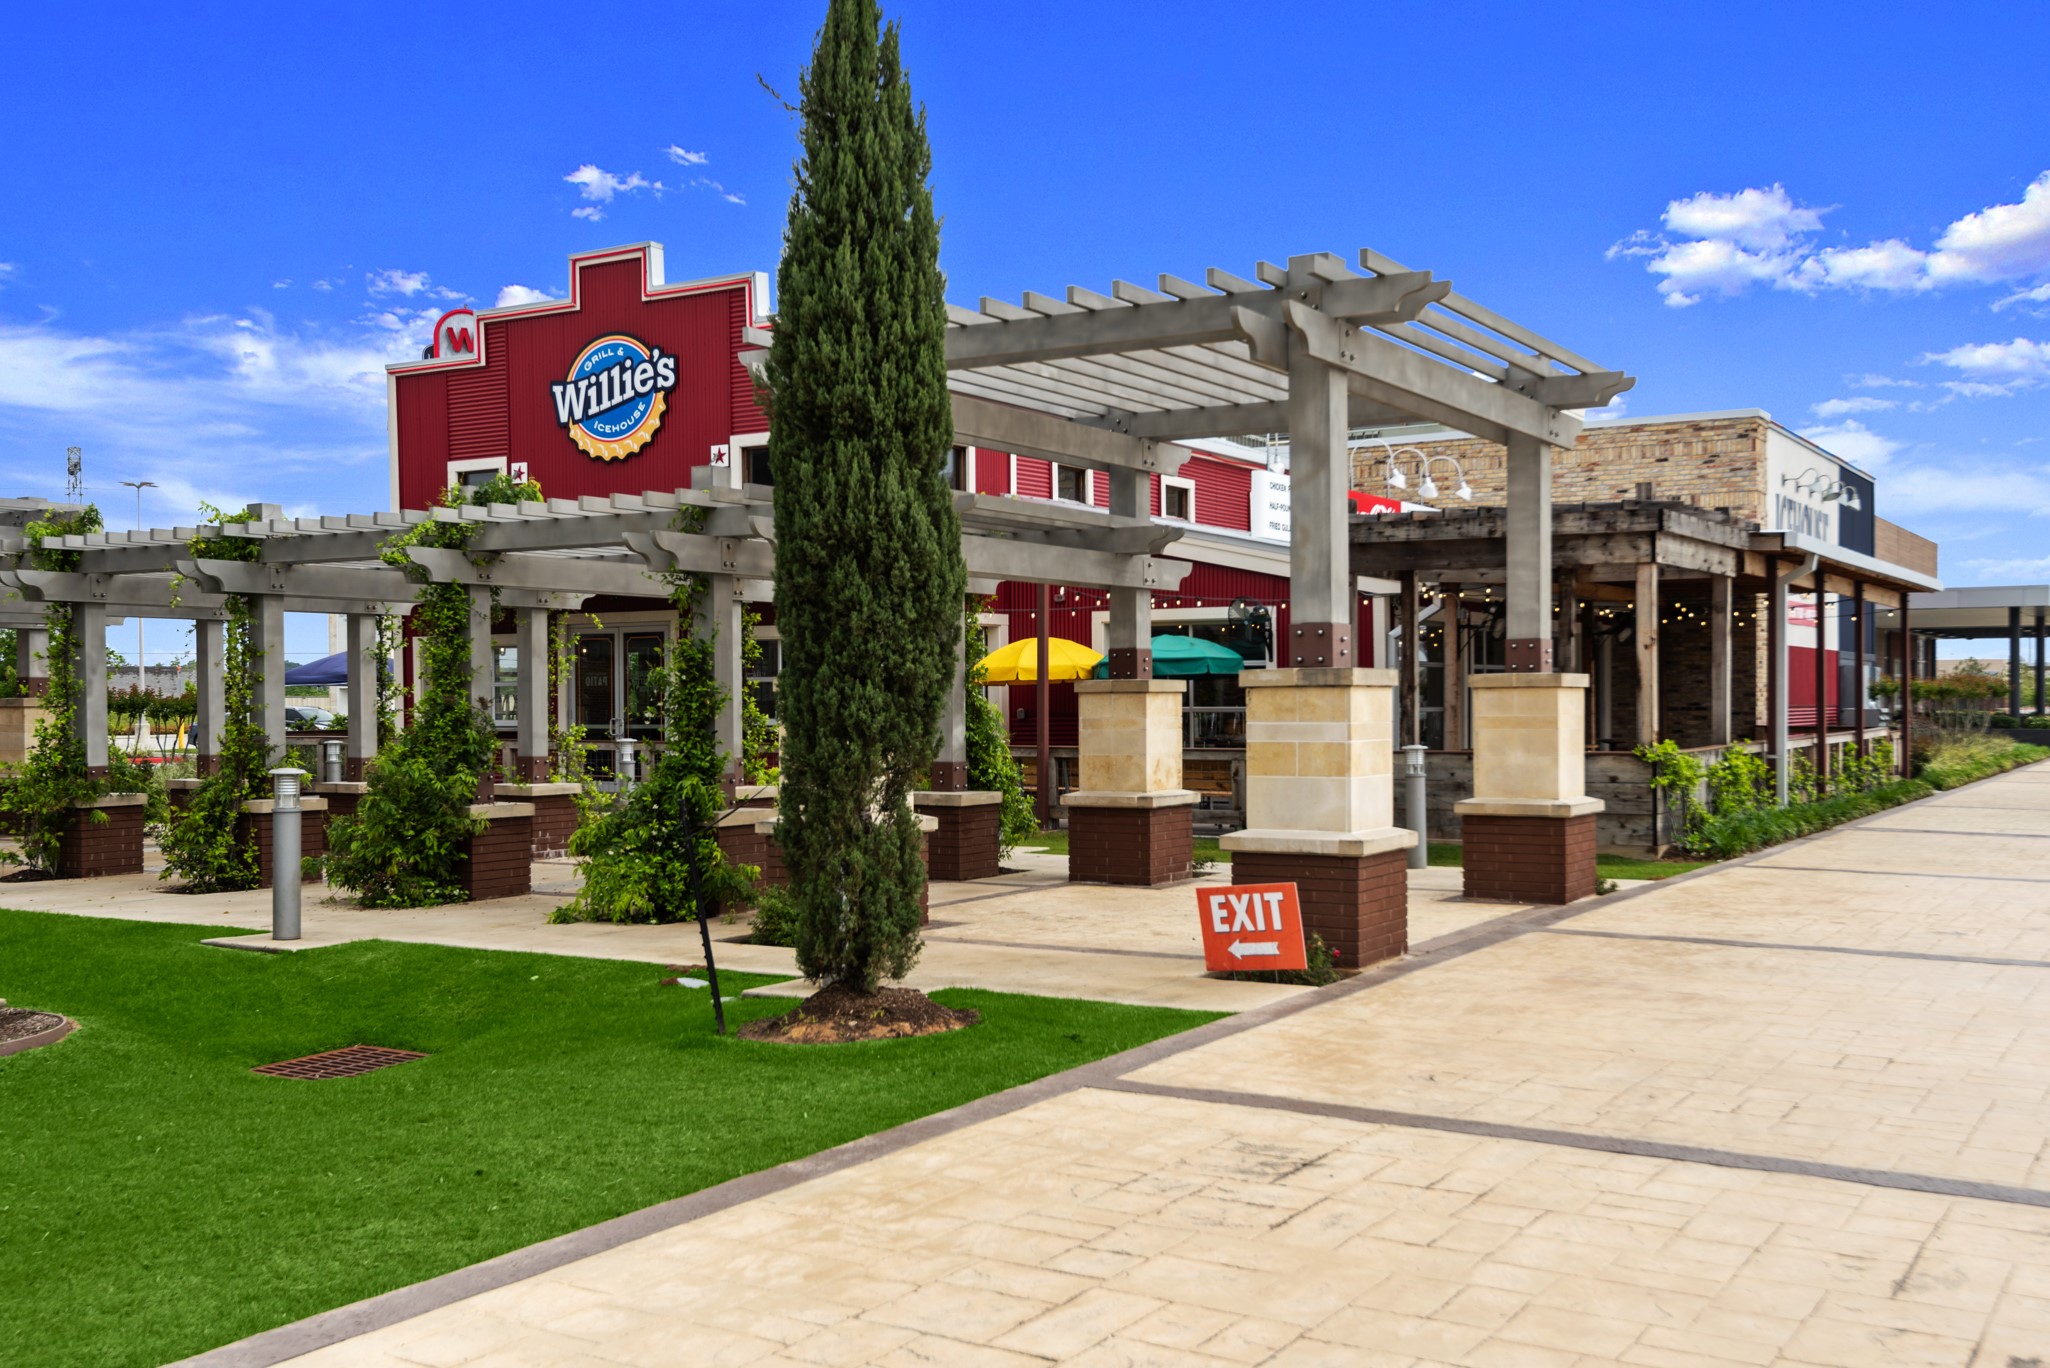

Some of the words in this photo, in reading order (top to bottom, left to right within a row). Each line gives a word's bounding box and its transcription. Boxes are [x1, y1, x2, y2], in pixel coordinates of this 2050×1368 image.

[584, 348, 615, 371] GRILL
[616, 346, 625, 356] &
[552, 349, 676, 424] Willie's
[594, 401, 646, 434] ICEHOUSE
[1209, 892, 1284, 933] EXIT
